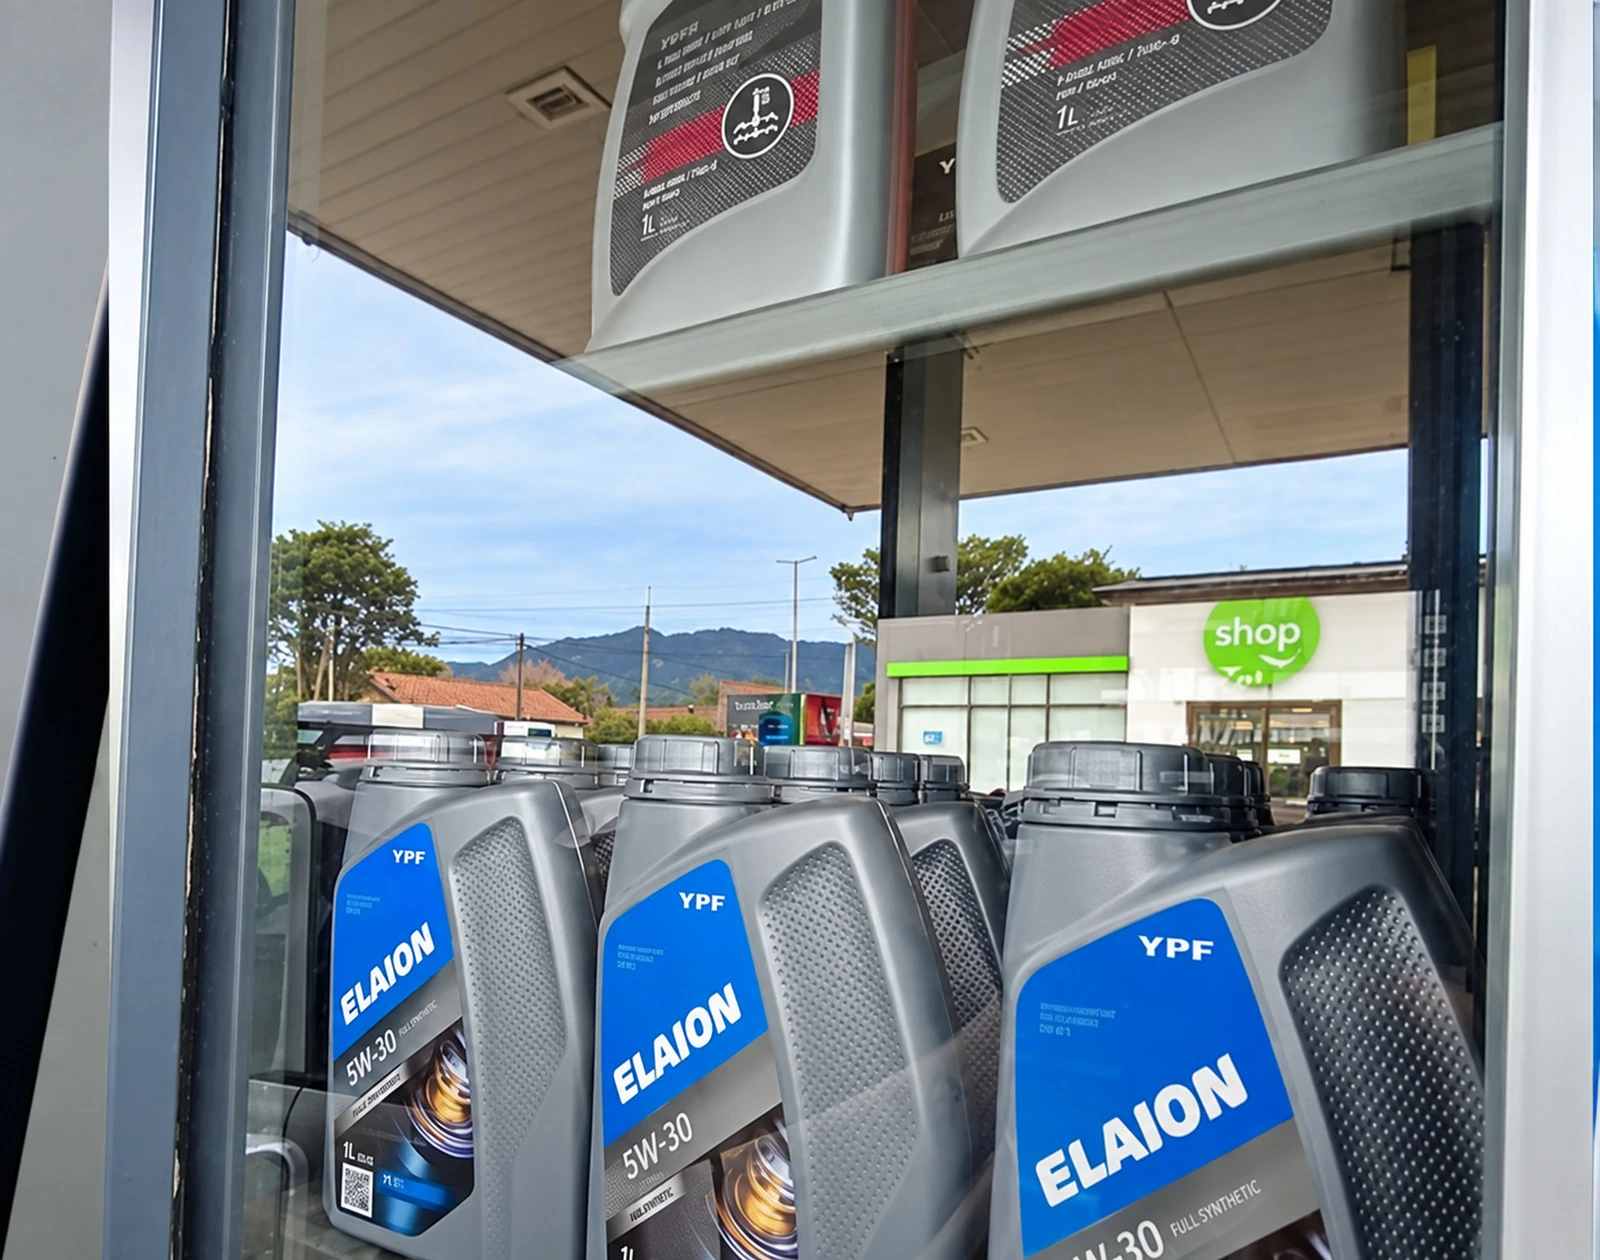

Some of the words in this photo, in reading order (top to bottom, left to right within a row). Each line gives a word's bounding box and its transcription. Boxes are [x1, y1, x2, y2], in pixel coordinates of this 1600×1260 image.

[1057, 105, 1078, 129] 1L
[641, 213, 656, 236] 1L
[1215, 616, 1302, 652] shop
[392, 849, 426, 865] YPF
[679, 891, 726, 912] YPF
[1138, 935, 1215, 961] YPF
[340, 921, 436, 1027] ELAION
[346, 1029, 397, 1087] 5W-30
[613, 982, 742, 1105] ELAION
[622, 1112, 694, 1180] 5W-30
[1035, 1053, 1248, 1208] ELAION
[343, 1141, 356, 1160] 1L
[1170, 1213, 1200, 1237] FULL
[1198, 1179, 1261, 1223] SYNTHETIC
